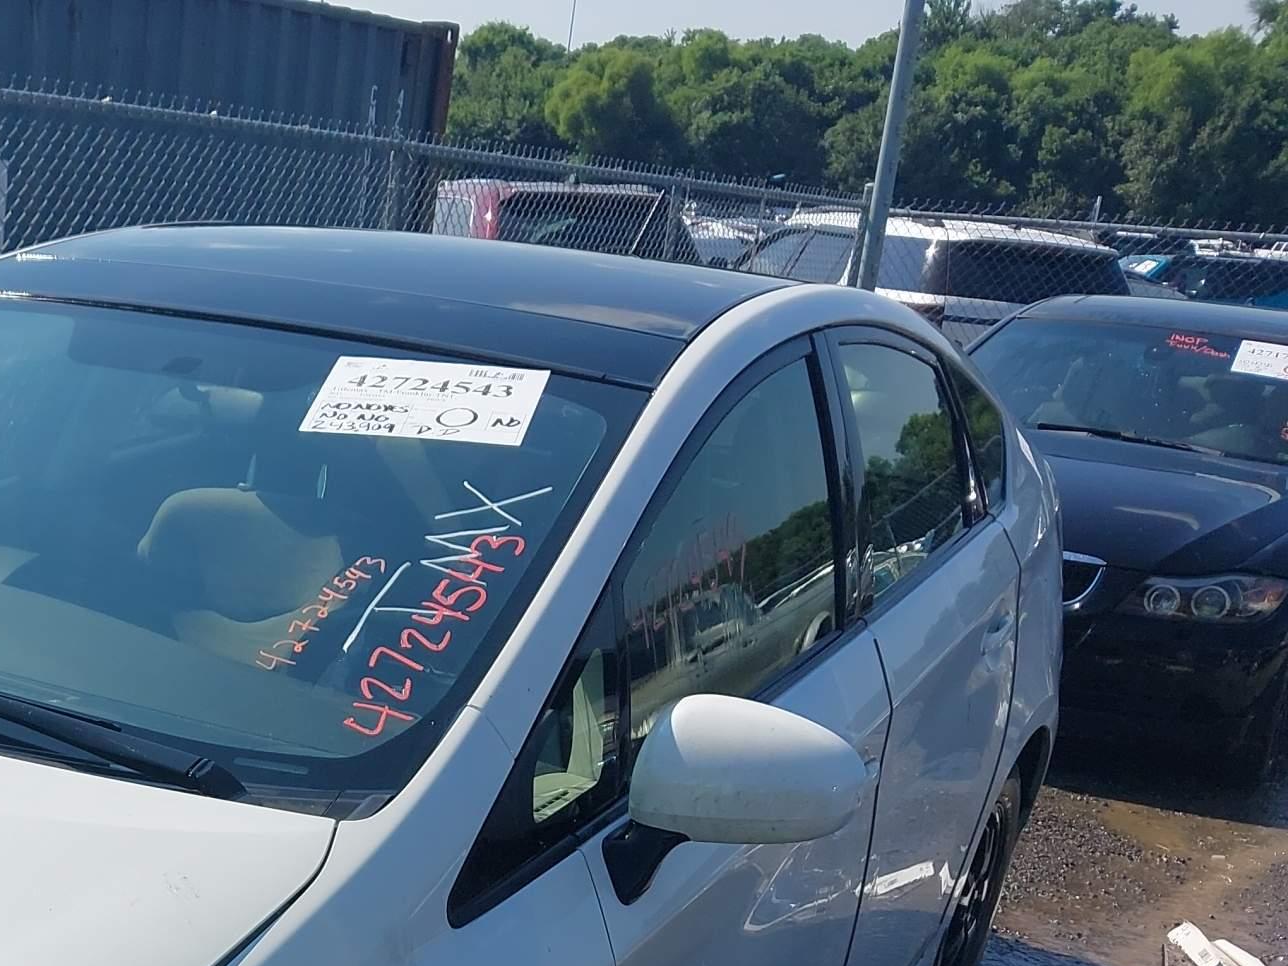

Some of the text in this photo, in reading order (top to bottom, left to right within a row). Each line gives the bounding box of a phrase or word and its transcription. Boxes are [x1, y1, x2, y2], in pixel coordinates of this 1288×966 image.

[347, 373, 514, 398] 42724543
[255, 556, 386, 671] 42724543
[343, 535, 525, 736] 42724543
